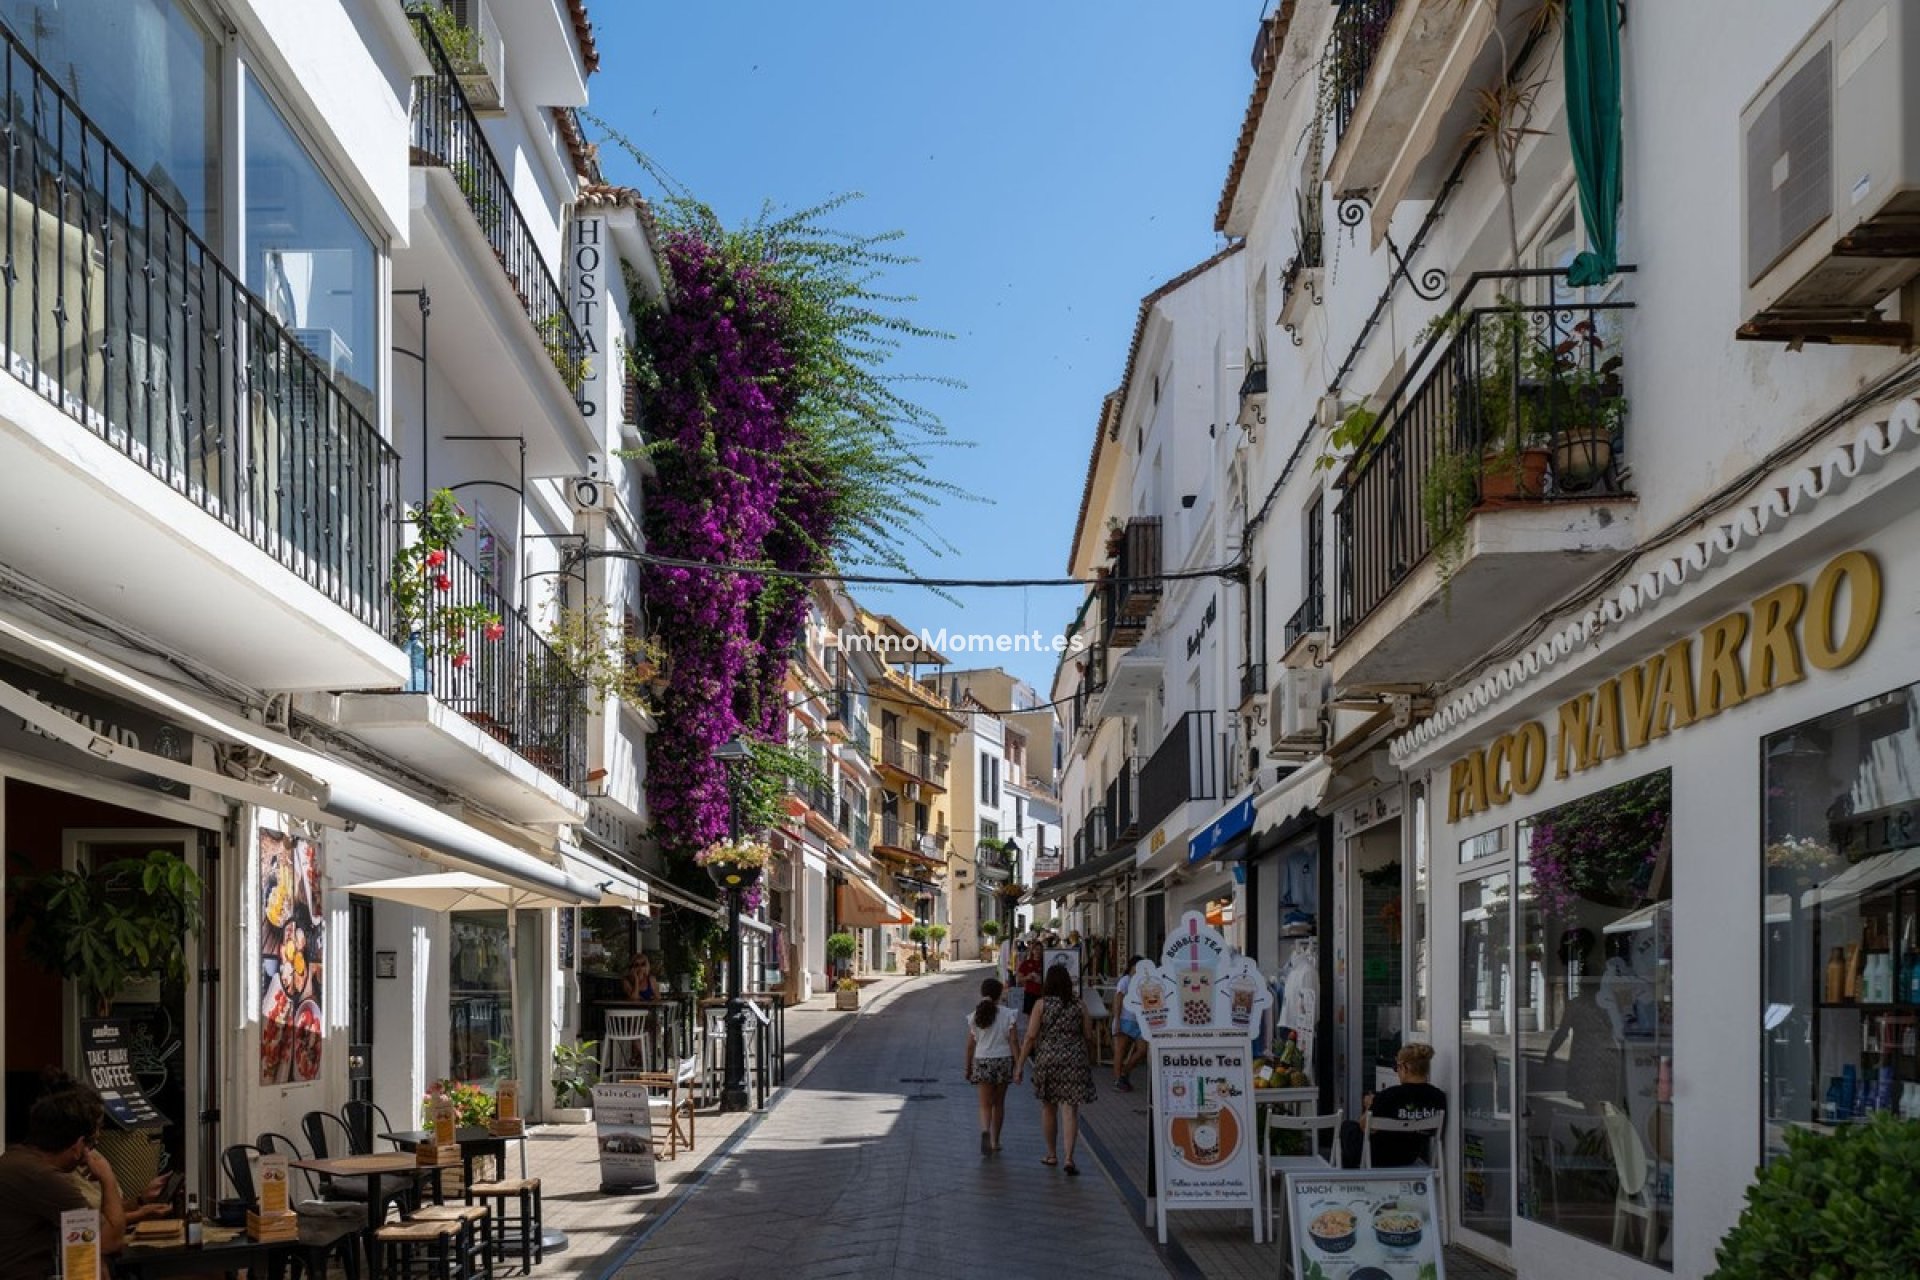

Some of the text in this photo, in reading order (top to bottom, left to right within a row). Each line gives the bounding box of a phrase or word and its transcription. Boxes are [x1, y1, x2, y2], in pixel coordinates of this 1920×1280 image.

[576, 219, 600, 381] HOSTA
[1447, 551, 1883, 824] PACO NAVARRO
[1166, 935, 1223, 958] BUBBLE TEA
[87, 1049, 128, 1066] TAKE AWAY
[1162, 1055, 1241, 1067] Bubble Tea
[91, 1065, 136, 1089] COFFEE
[1295, 1185, 1332, 1195] LUNCH
